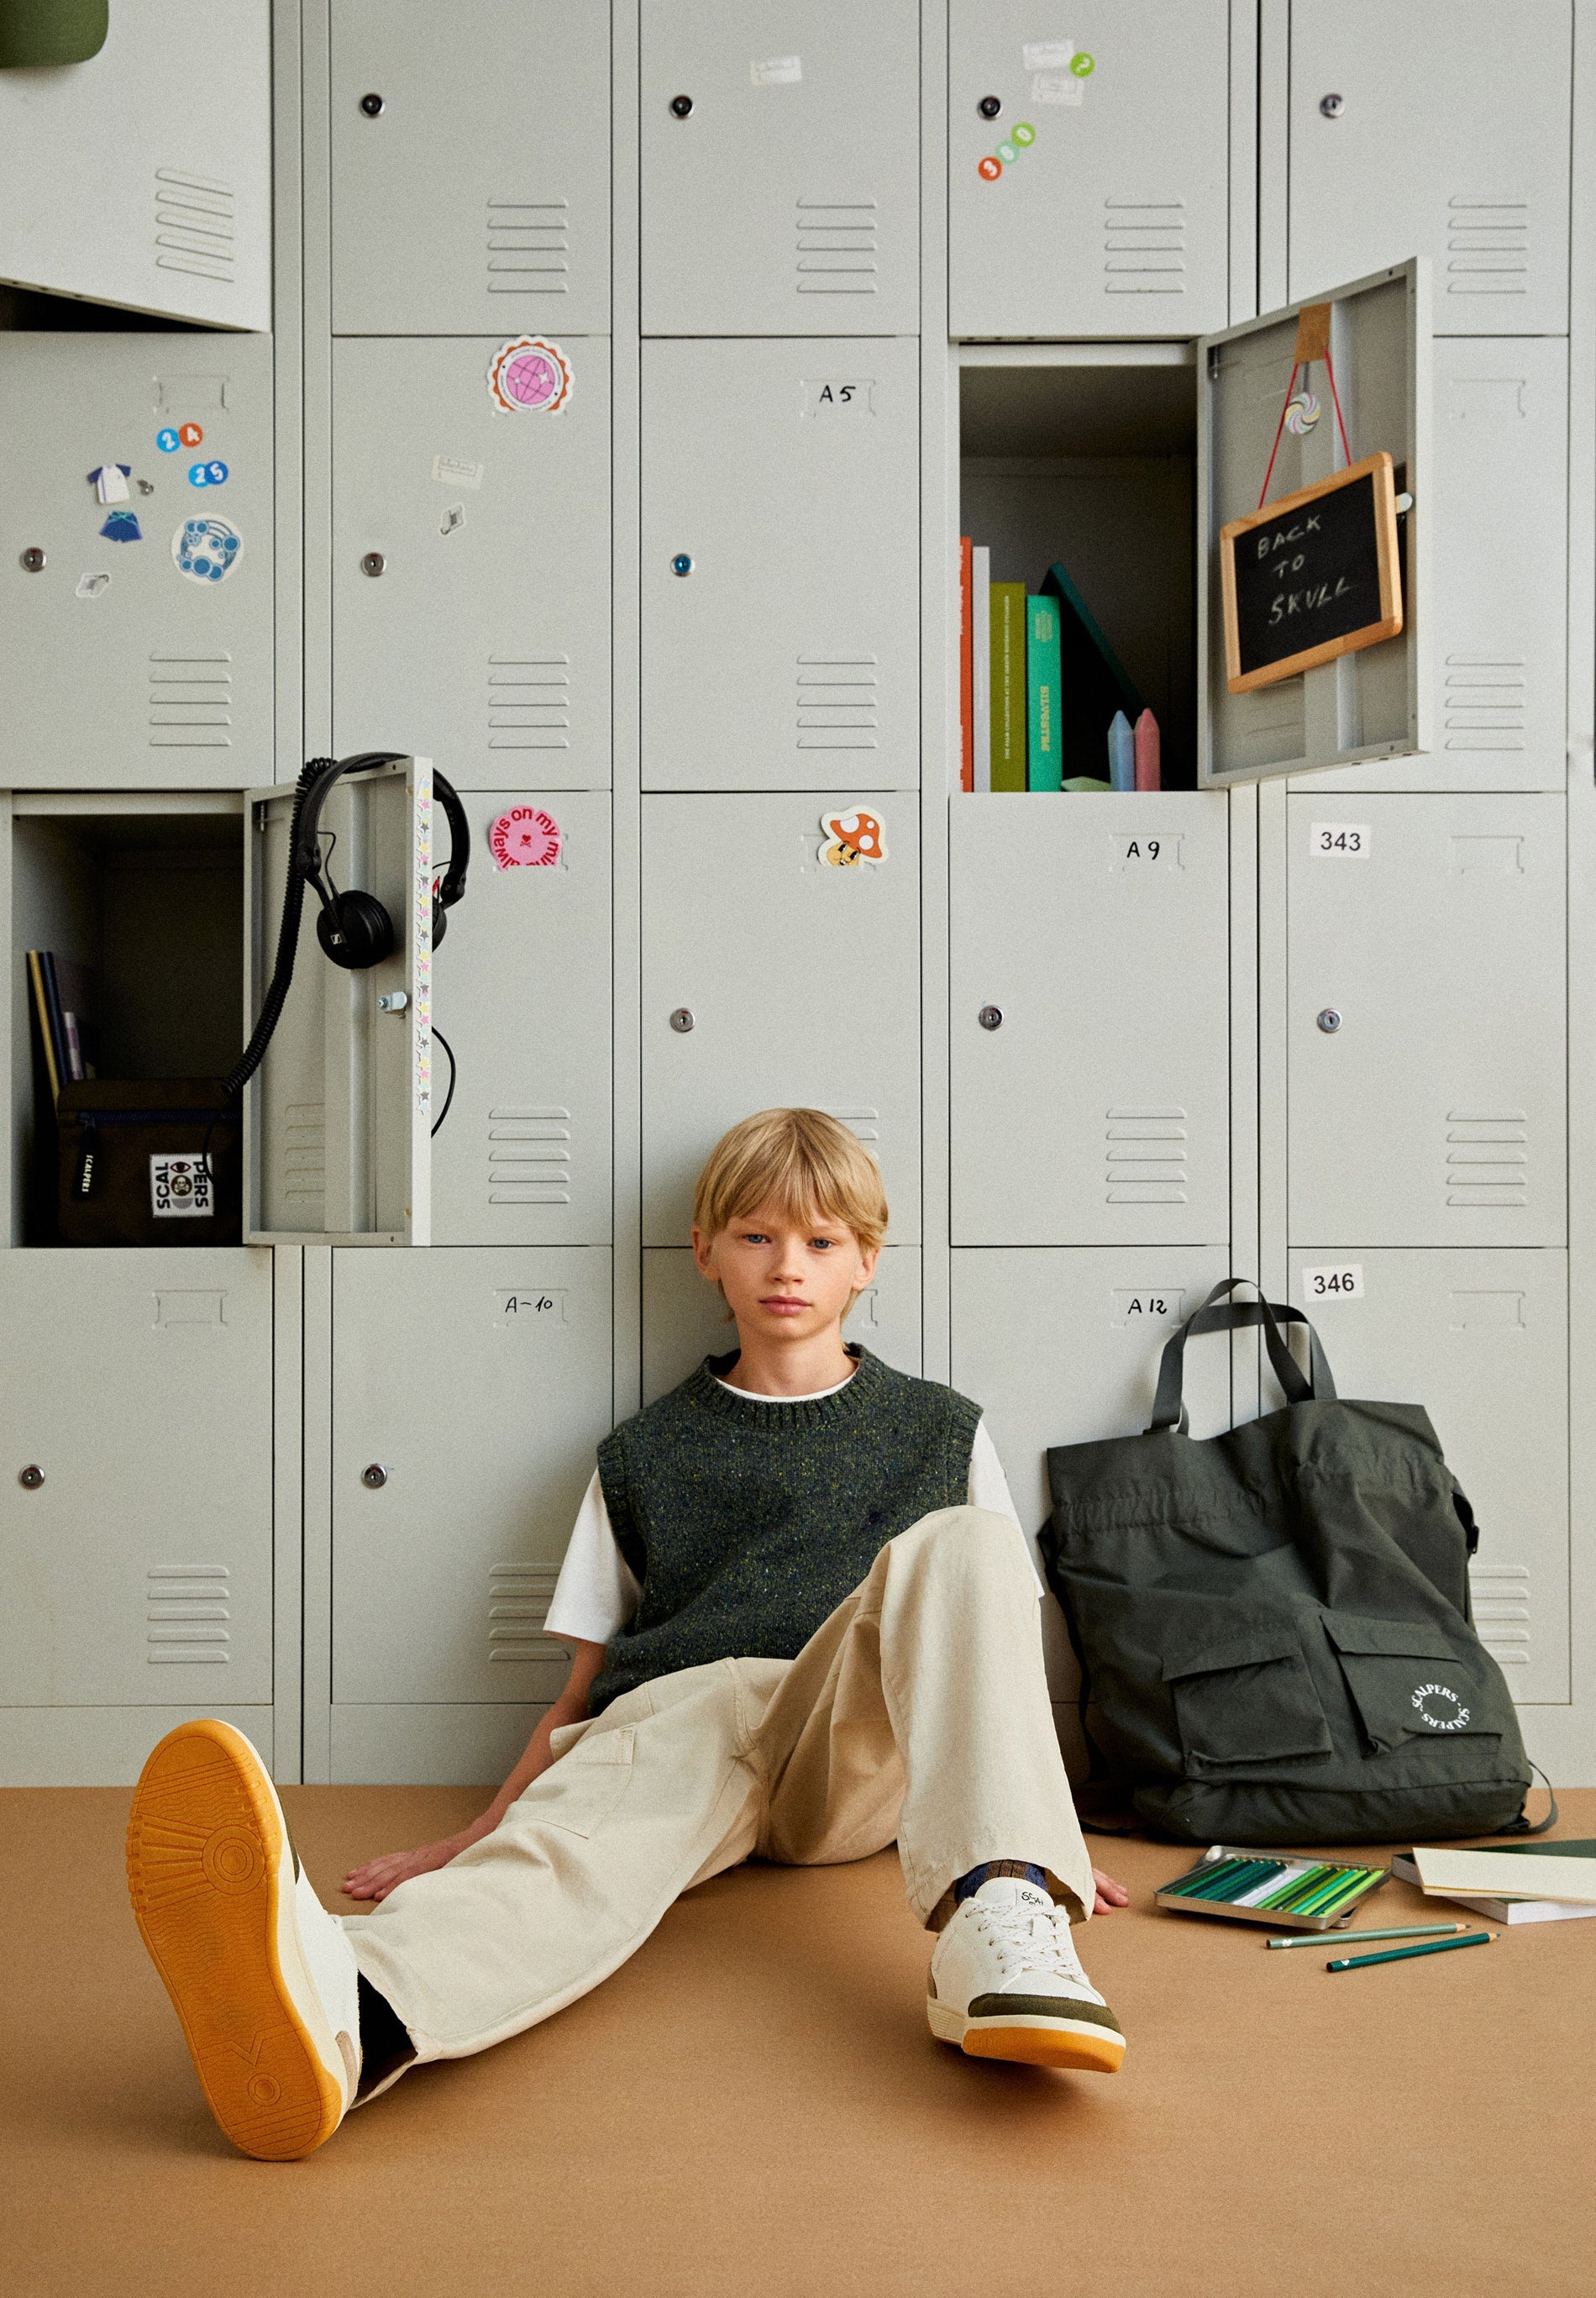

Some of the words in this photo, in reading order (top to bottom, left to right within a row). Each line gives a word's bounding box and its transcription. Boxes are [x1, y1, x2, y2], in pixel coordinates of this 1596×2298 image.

[1257, 514, 1321, 560] BACK
[1272, 554, 1305, 578] TO
[511, 808, 533, 822] on
[535, 812, 558, 836] my
[1320, 831, 1362, 852] 343
[155, 1162, 171, 1209] SCAL
[193, 1161, 209, 1208] PERS
[1313, 1272, 1355, 1294] 346
[1411, 1684, 1459, 1710] SCALPERS
[1421, 1707, 1471, 1730] SCALPERS
